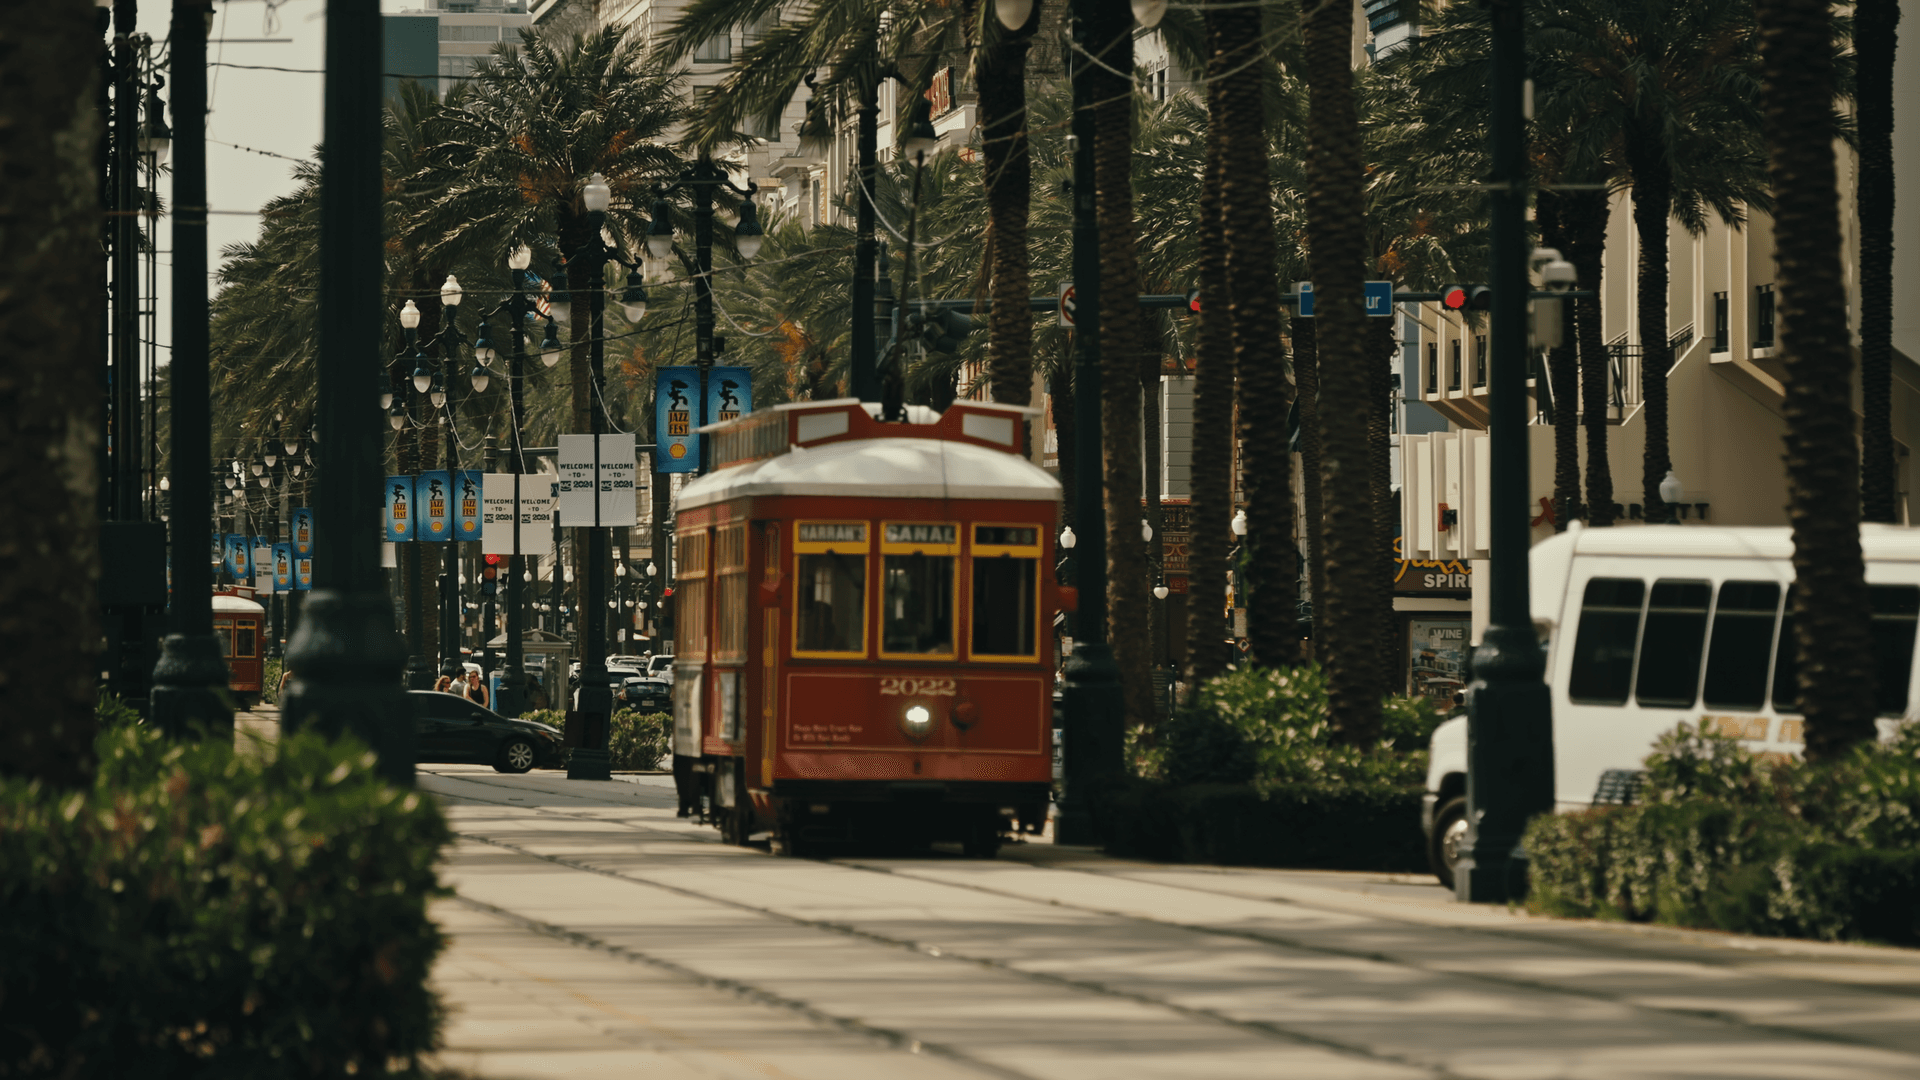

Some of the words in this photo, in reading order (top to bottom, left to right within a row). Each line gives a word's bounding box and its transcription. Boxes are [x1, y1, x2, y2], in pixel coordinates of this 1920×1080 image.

[670, 412, 688, 421] JAZZ
[669, 424, 688, 434] FEST
[885, 526, 954, 542] CANAL
[1433, 629, 1462, 639] WINE
[880, 679, 956, 696] 2022
